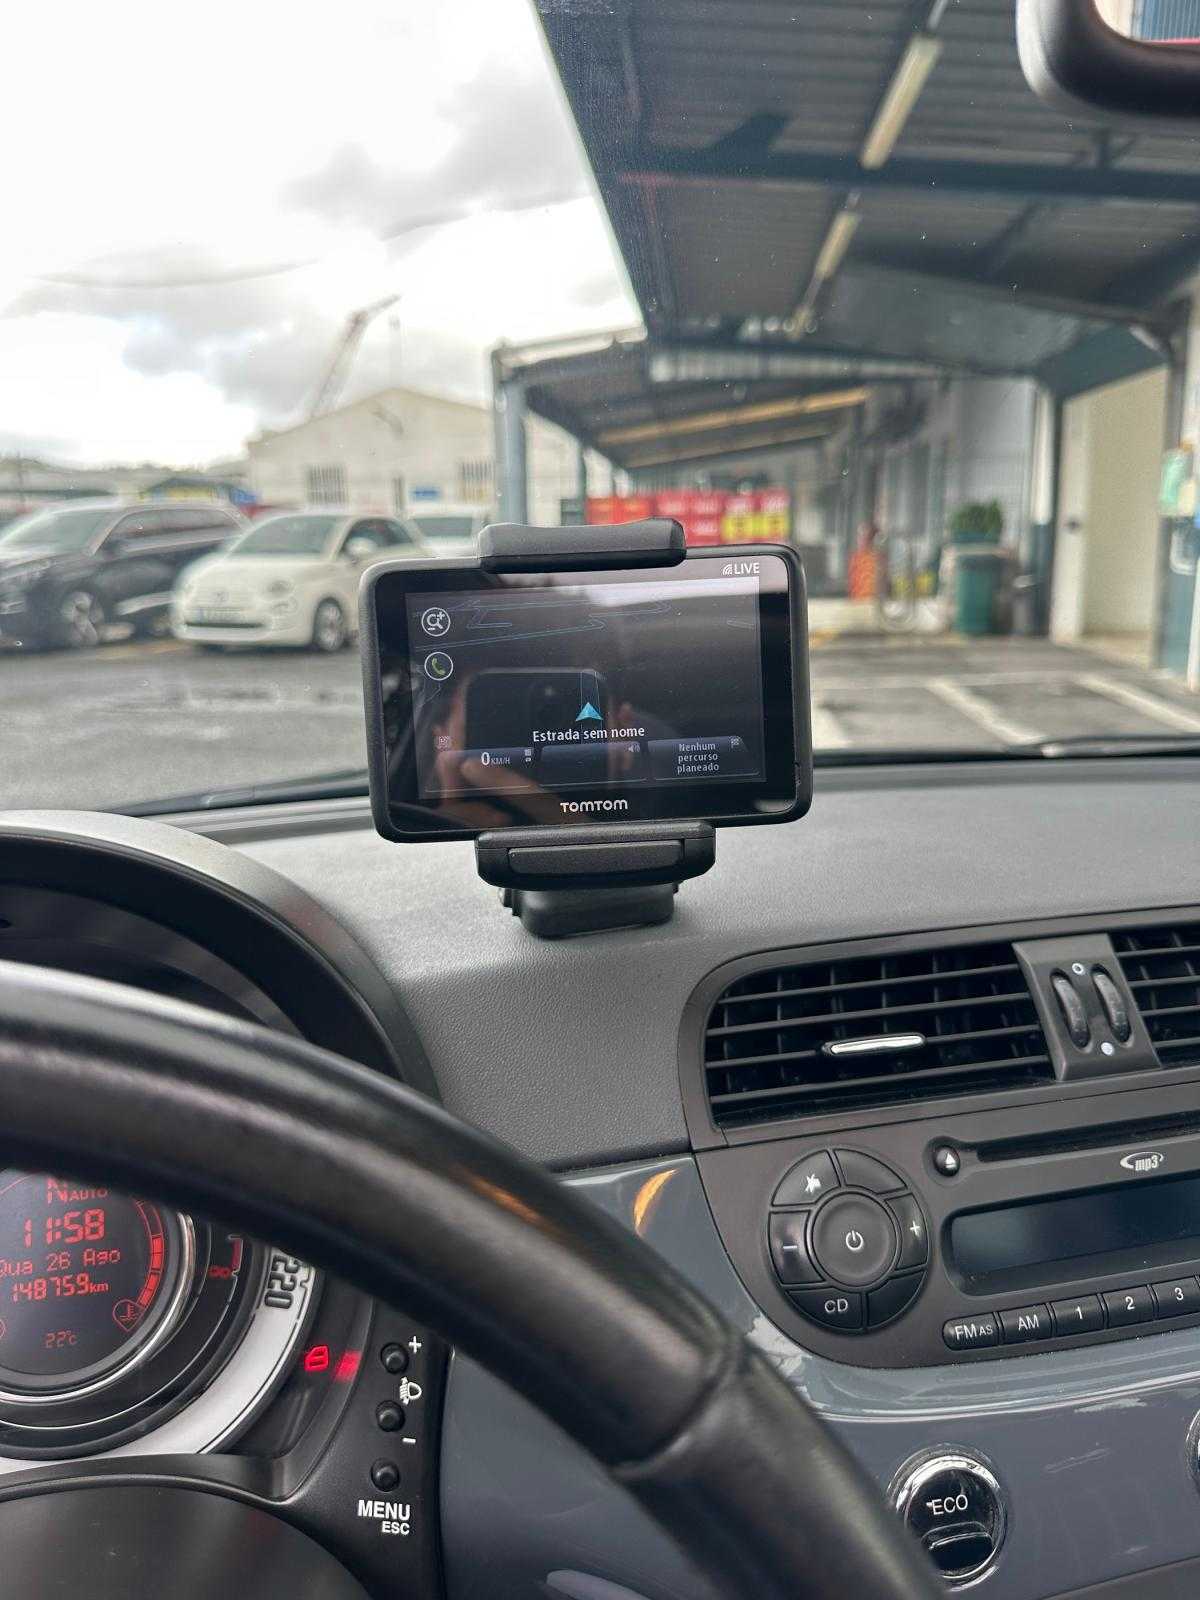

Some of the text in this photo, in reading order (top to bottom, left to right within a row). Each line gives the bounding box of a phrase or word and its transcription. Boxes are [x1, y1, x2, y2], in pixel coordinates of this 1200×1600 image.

[734, 563, 760, 576] LIVE
[532, 727, 645, 743] Estrada sem nome
[679, 742, 716, 752] Nenhum
[678, 752, 718, 764] percurso
[677, 763, 719, 775] planeado
[1135, 1154, 1158, 1171] mp3
[24, 1208, 105, 1249] 11:58
[47, 1251, 71, 1272] 26
[264, 1254, 299, 1310] 220
[1174, 1287, 1184, 1300] 3
[824, 1298, 849, 1313] CD
[1124, 1296, 1135, 1310] 2
[1075, 1306, 1084, 1320] 1
[1017, 1315, 1040, 1331] AM
[357, 1500, 411, 1521] MENU
[932, 1495, 968, 1515] ECO
[381, 1521, 410, 1535] ESC
